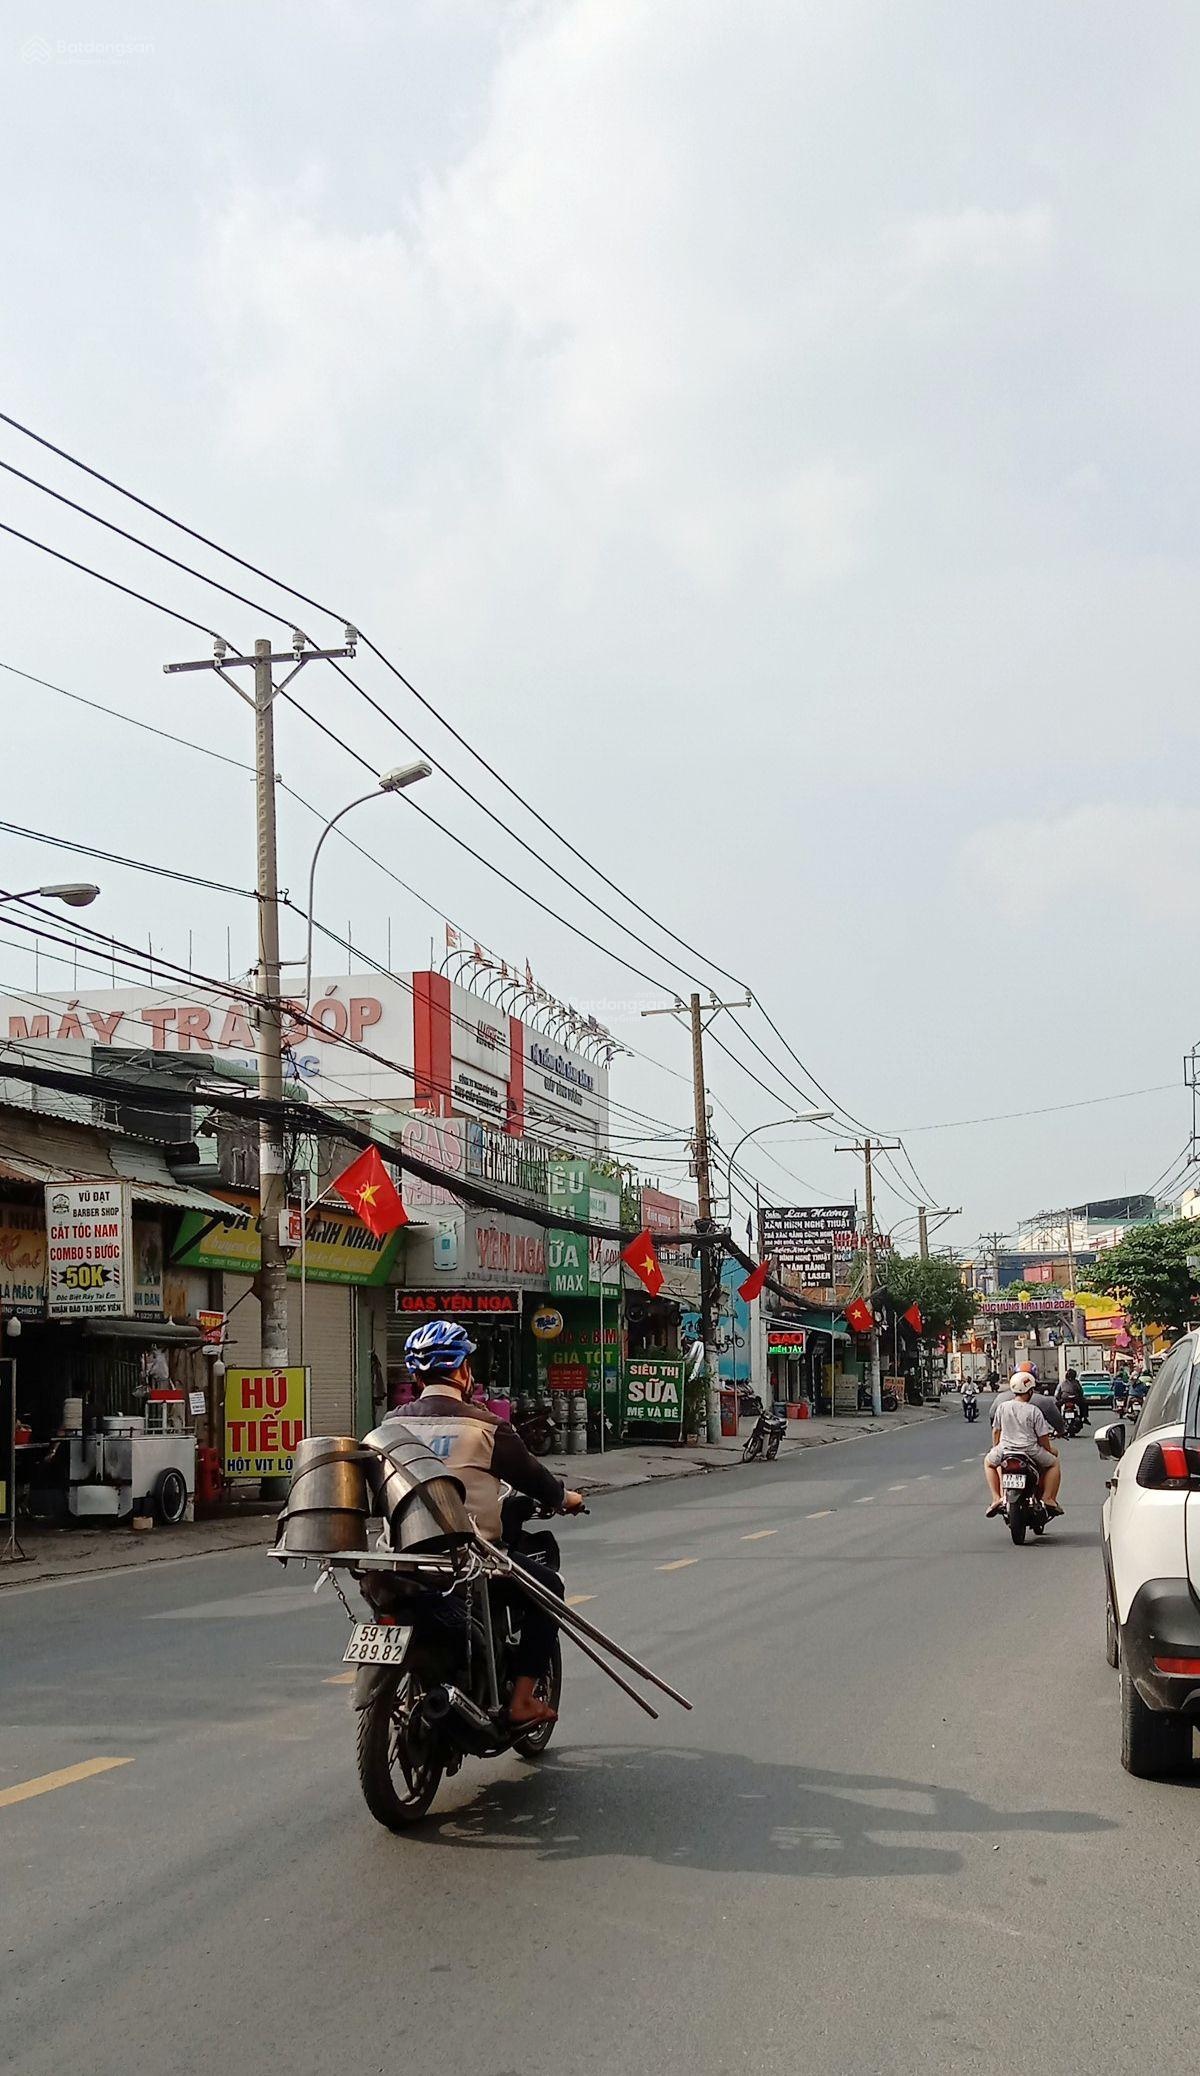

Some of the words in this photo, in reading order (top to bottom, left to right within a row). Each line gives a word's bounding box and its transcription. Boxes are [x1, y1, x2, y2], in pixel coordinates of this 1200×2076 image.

[401, 1120, 463, 1172] GAS
[78, 1190, 91, 1203] VŨ
[92, 1190, 110, 1204] ĐẠT
[72, 1208, 100, 1218] BARBER
[101, 1207, 119, 1217] SHOP
[51, 1222, 70, 1240] CẮT
[72, 1222, 91, 1239] TÓC
[94, 1223, 118, 1238] NAM
[50, 1246, 83, 1261] COMBO
[86, 1246, 92, 1259] 5
[94, 1243, 120, 1259] BƯỚC
[65, 1264, 105, 1289] 50K
[555, 1274, 584, 1292] MAX
[402, 1295, 437, 1311] GAS
[477, 1295, 513, 1311] NGA
[629, 1363, 657, 1376] SIÊU
[660, 1366, 679, 1379] THỊ
[241, 1369, 288, 1410] HỦ
[628, 1378, 679, 1403] SỮA
[626, 1407, 645, 1419] MẸ
[646, 1406, 662, 1418] VÀ
[664, 1406, 679, 1418] BÉ
[226, 1409, 303, 1453] TIẾU
[227, 1457, 252, 1475] HỘT
[254, 1458, 274, 1474] VỊT
[360, 1626, 402, 1644] 59-K1
[347, 1643, 402, 1661] 289.82
